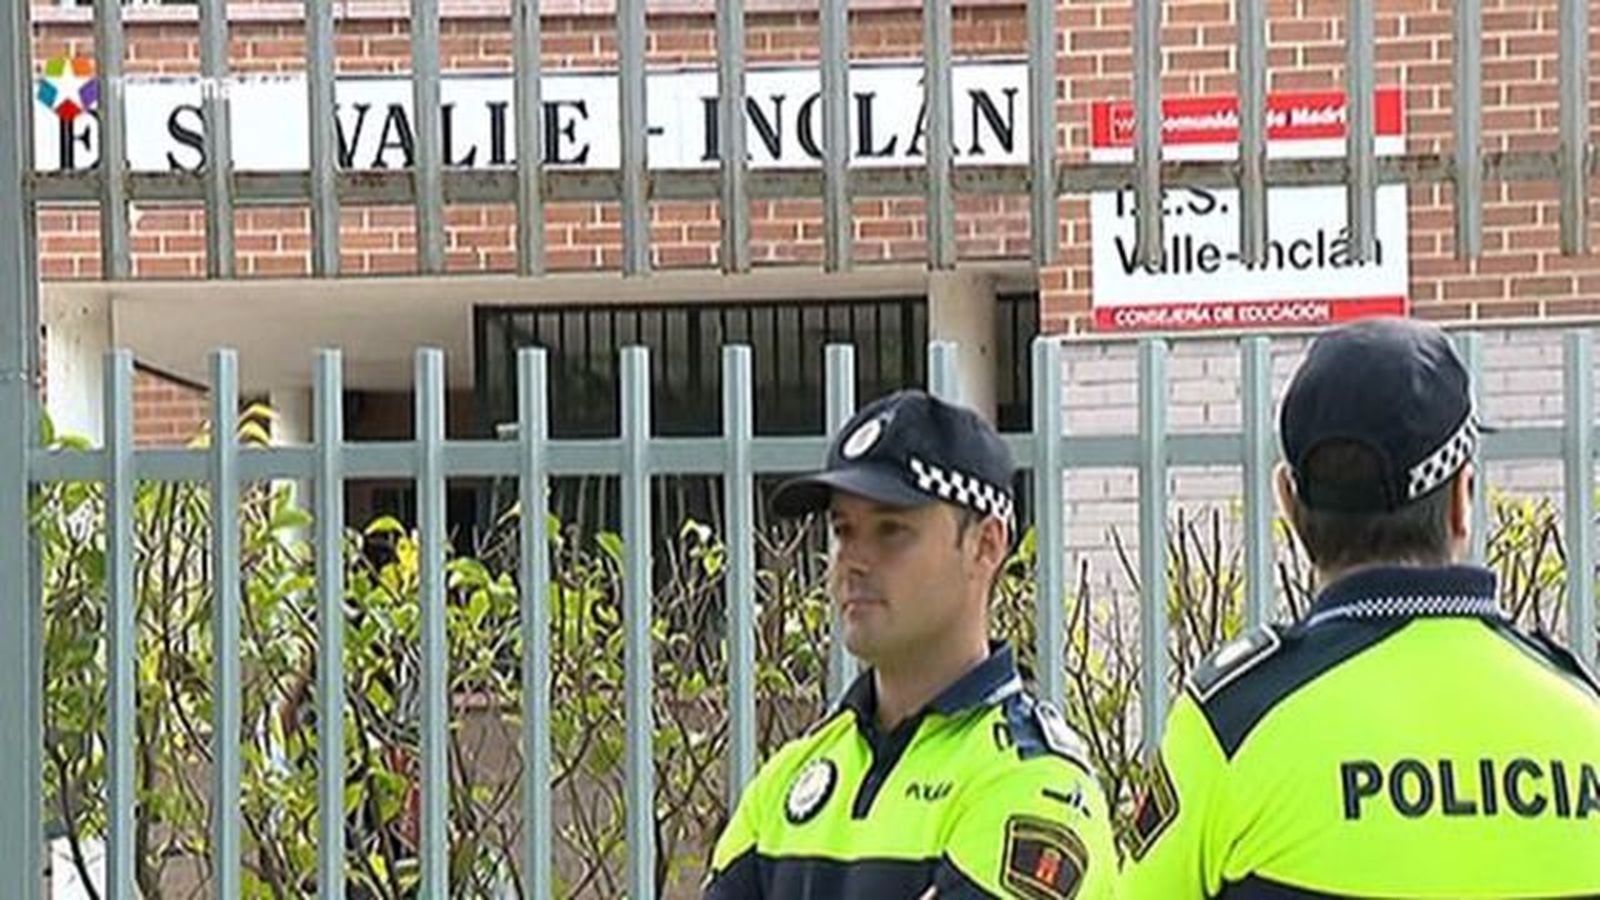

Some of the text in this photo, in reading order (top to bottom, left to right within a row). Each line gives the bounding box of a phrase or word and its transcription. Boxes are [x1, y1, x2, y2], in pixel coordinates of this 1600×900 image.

[334, 99, 590, 168] VALLE
[1160, 109, 1240, 133] omunida
[1291, 105, 1347, 126] Madri
[1116, 186, 1228, 217] I..S.
[1114, 229, 1382, 275] Vlle-nclá
[1213, 305, 1234, 322] DE
[1238, 302, 1330, 321] EDUCACIÓN
